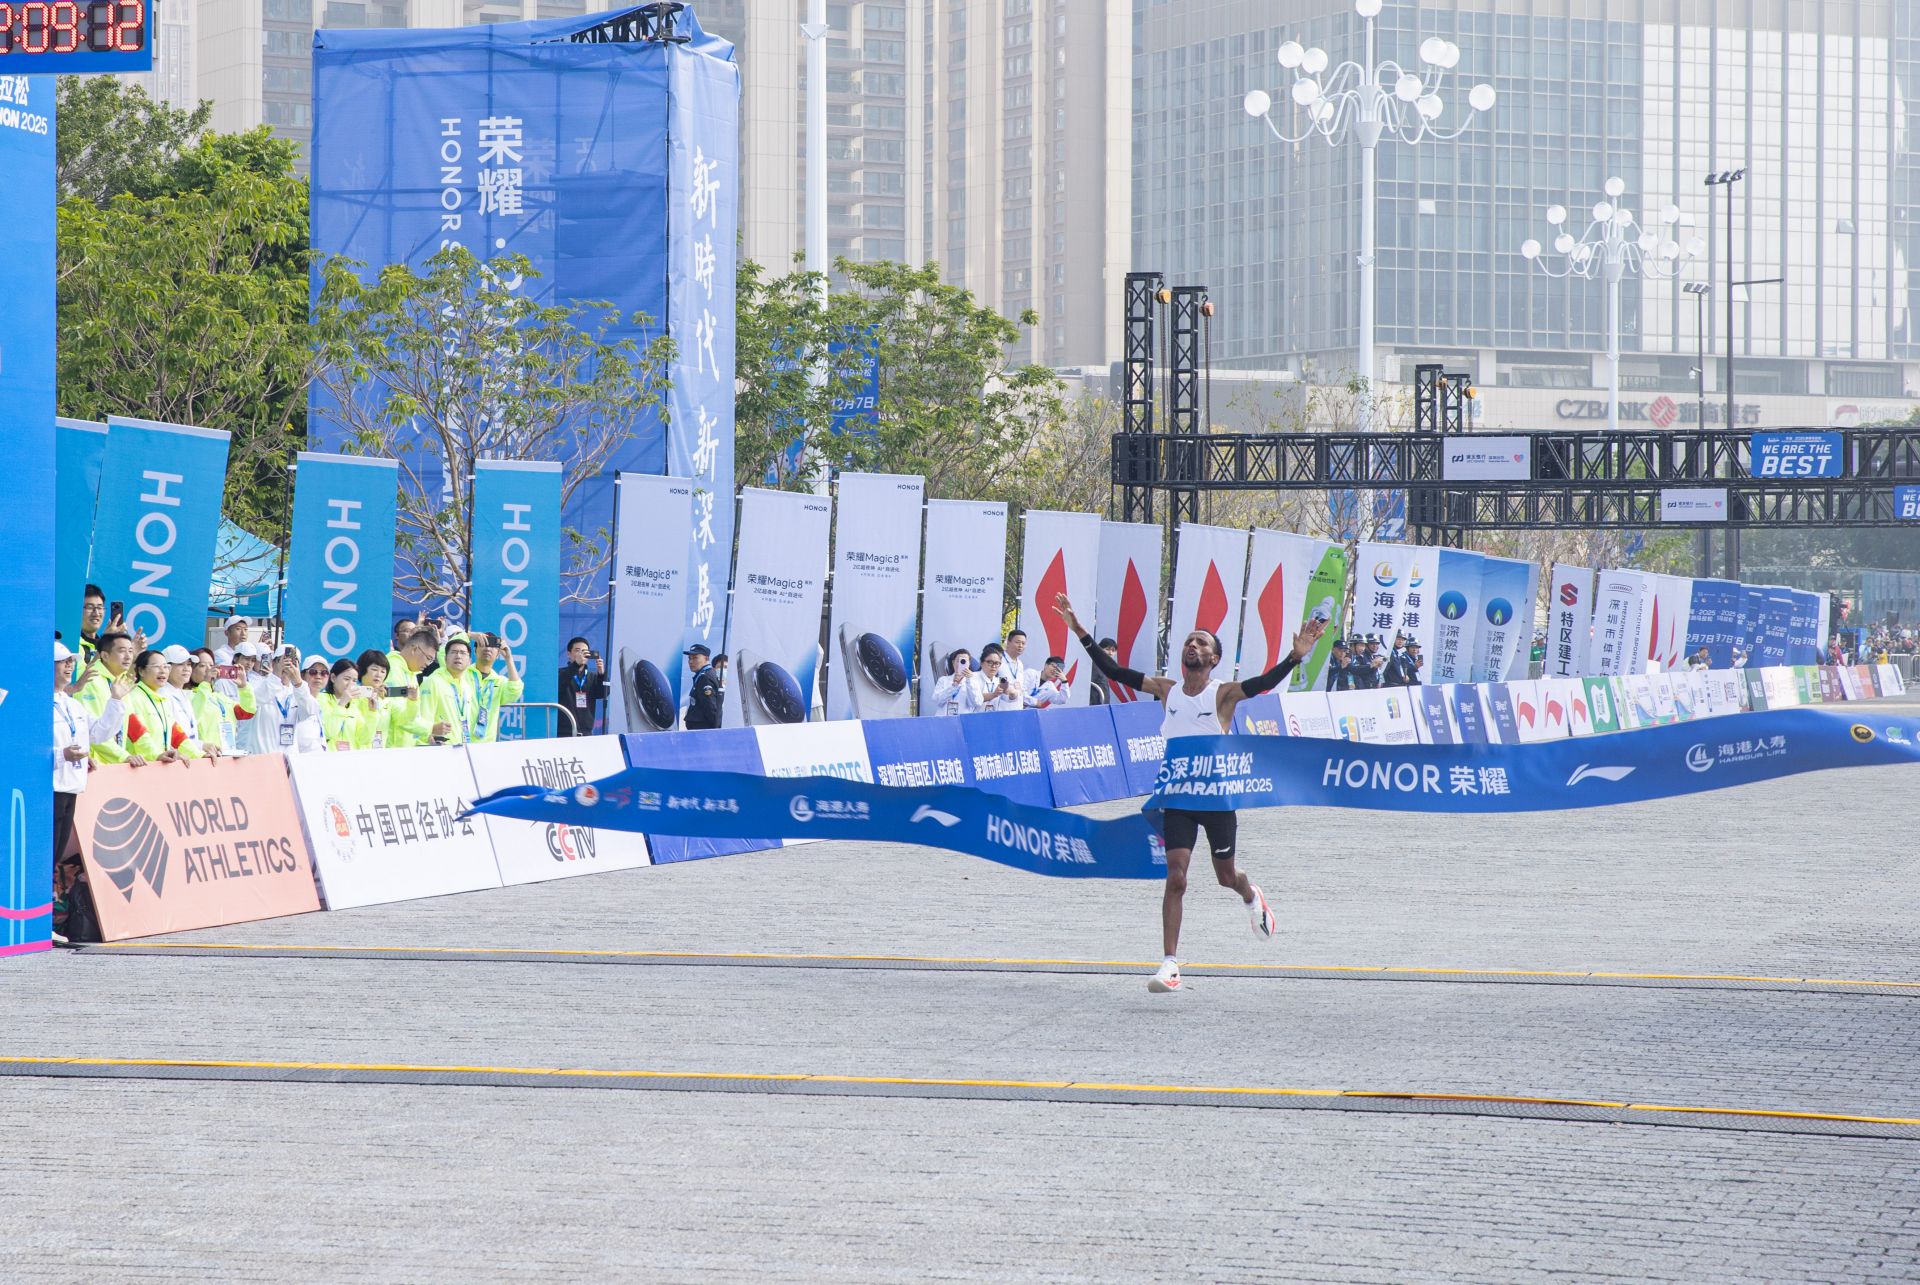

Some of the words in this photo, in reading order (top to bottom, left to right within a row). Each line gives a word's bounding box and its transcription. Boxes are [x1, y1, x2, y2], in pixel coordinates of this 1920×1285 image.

[0, 107, 20, 129] ON
[21, 111, 48, 136] 2025
[440, 118, 462, 232] HONOR
[1555, 398, 1649, 421] CZBNK
[1761, 455, 1832, 475] BEST
[1762, 444, 1779, 454] WE
[1782, 444, 1806, 454] ARE
[1809, 444, 1832, 454] THE
[669, 487, 689, 496] HONOR
[804, 504, 828, 513] HONOR
[319, 498, 363, 660] HONO
[1441, 624, 1461, 679] 深燃优选
[1487, 630, 1506, 683] 深燃优选
[1556, 611, 1574, 676] 特区建工
[1049, 743, 1116, 773] 深圳市宝安区人民政府
[1718, 735, 1787, 756] 海港人寿
[1719, 752, 1764, 765] HARBOUR
[1766, 748, 1787, 758] LIFE
[876, 758, 965, 787] 深圳市福田区人民政府
[973, 748, 1042, 782] 深圳市南山区人民政府
[1154, 752, 1254, 784] 5深圳马拉松
[1322, 758, 1443, 794] HONOR
[1448, 765, 1512, 796] 荣耀
[1164, 780, 1245, 796] MARATHON
[1245, 778, 1273, 793] 2025
[166, 796, 249, 838] WORLD
[355, 796, 476, 849] 中国田径协会
[545, 822, 597, 862] CCTV
[986, 813, 1054, 861] HONOR
[1054, 833, 1097, 865] 荣耀
[183, 836, 298, 884] ATHLETICS
